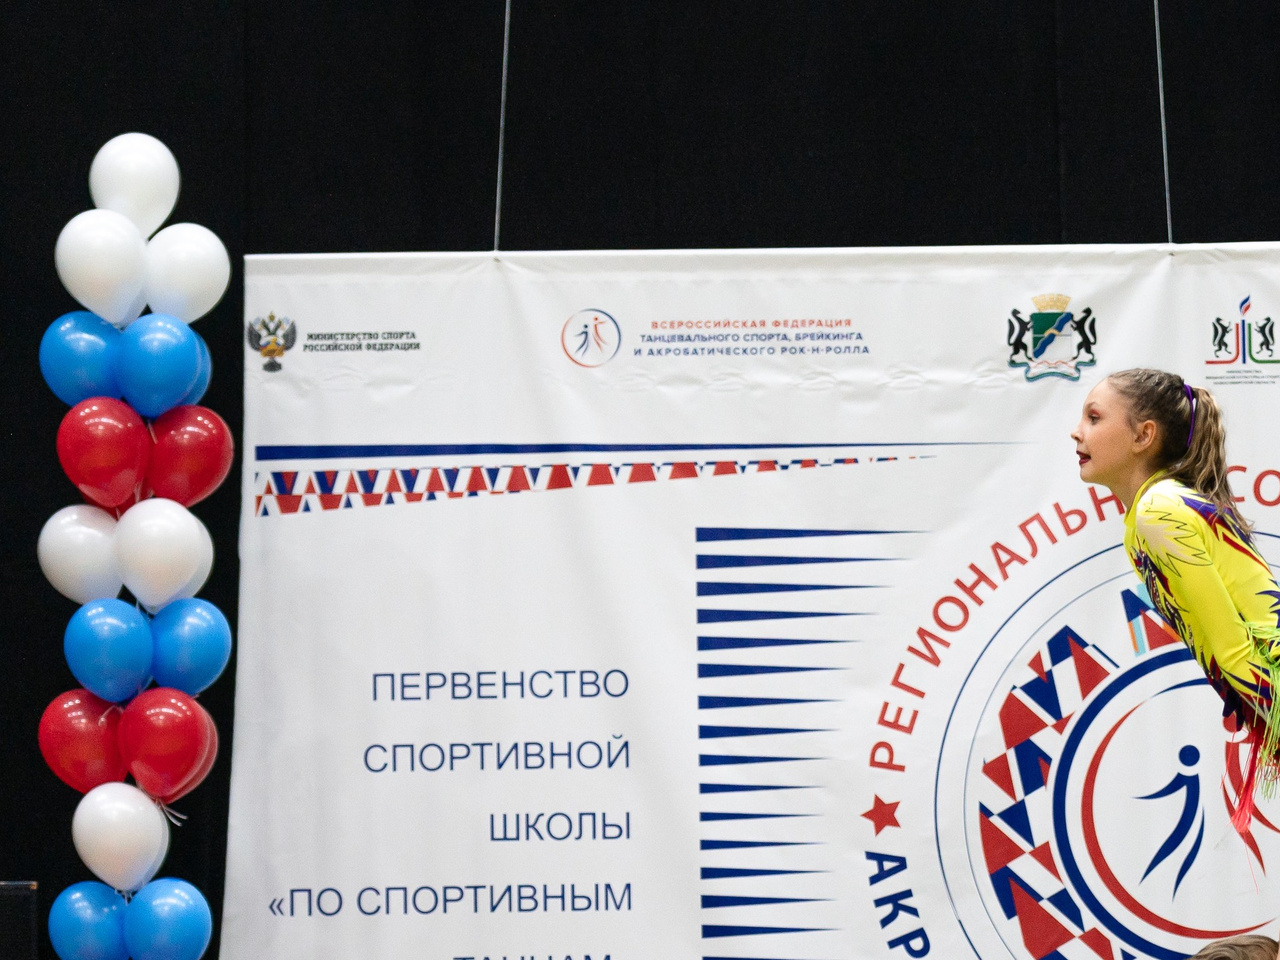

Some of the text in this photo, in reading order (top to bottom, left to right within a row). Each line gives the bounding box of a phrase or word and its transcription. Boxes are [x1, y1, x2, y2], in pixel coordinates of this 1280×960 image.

[651, 318, 852, 330] ВСЕРОССИЙСКАЯ ФЕДЕРАЦИЯ
[303, 342, 421, 352] РОССИЙСКОЙ ФЕДЕРАЦИИ
[306, 331, 416, 342] МИНИСТЕРСТВО СПОРТА
[640, 331, 863, 344] ТАНЦЕВАЛЬНОГО СПОРТА, БРЕЙКИНГА
[633, 345, 871, 357] И АКРОБАТИЧЕСКОГО РОК-Н-РОЛЛА
[868, 485, 1127, 773] РЕГИОНАЛЬН
[372, 668, 629, 701] ПЕРВЕНСТВО
[363, 734, 630, 773] СПОРТИВНОЙ
[489, 811, 631, 842] ШКОЛЫ
[268, 882, 632, 917] «ПО СПОРТИВНЫМ
